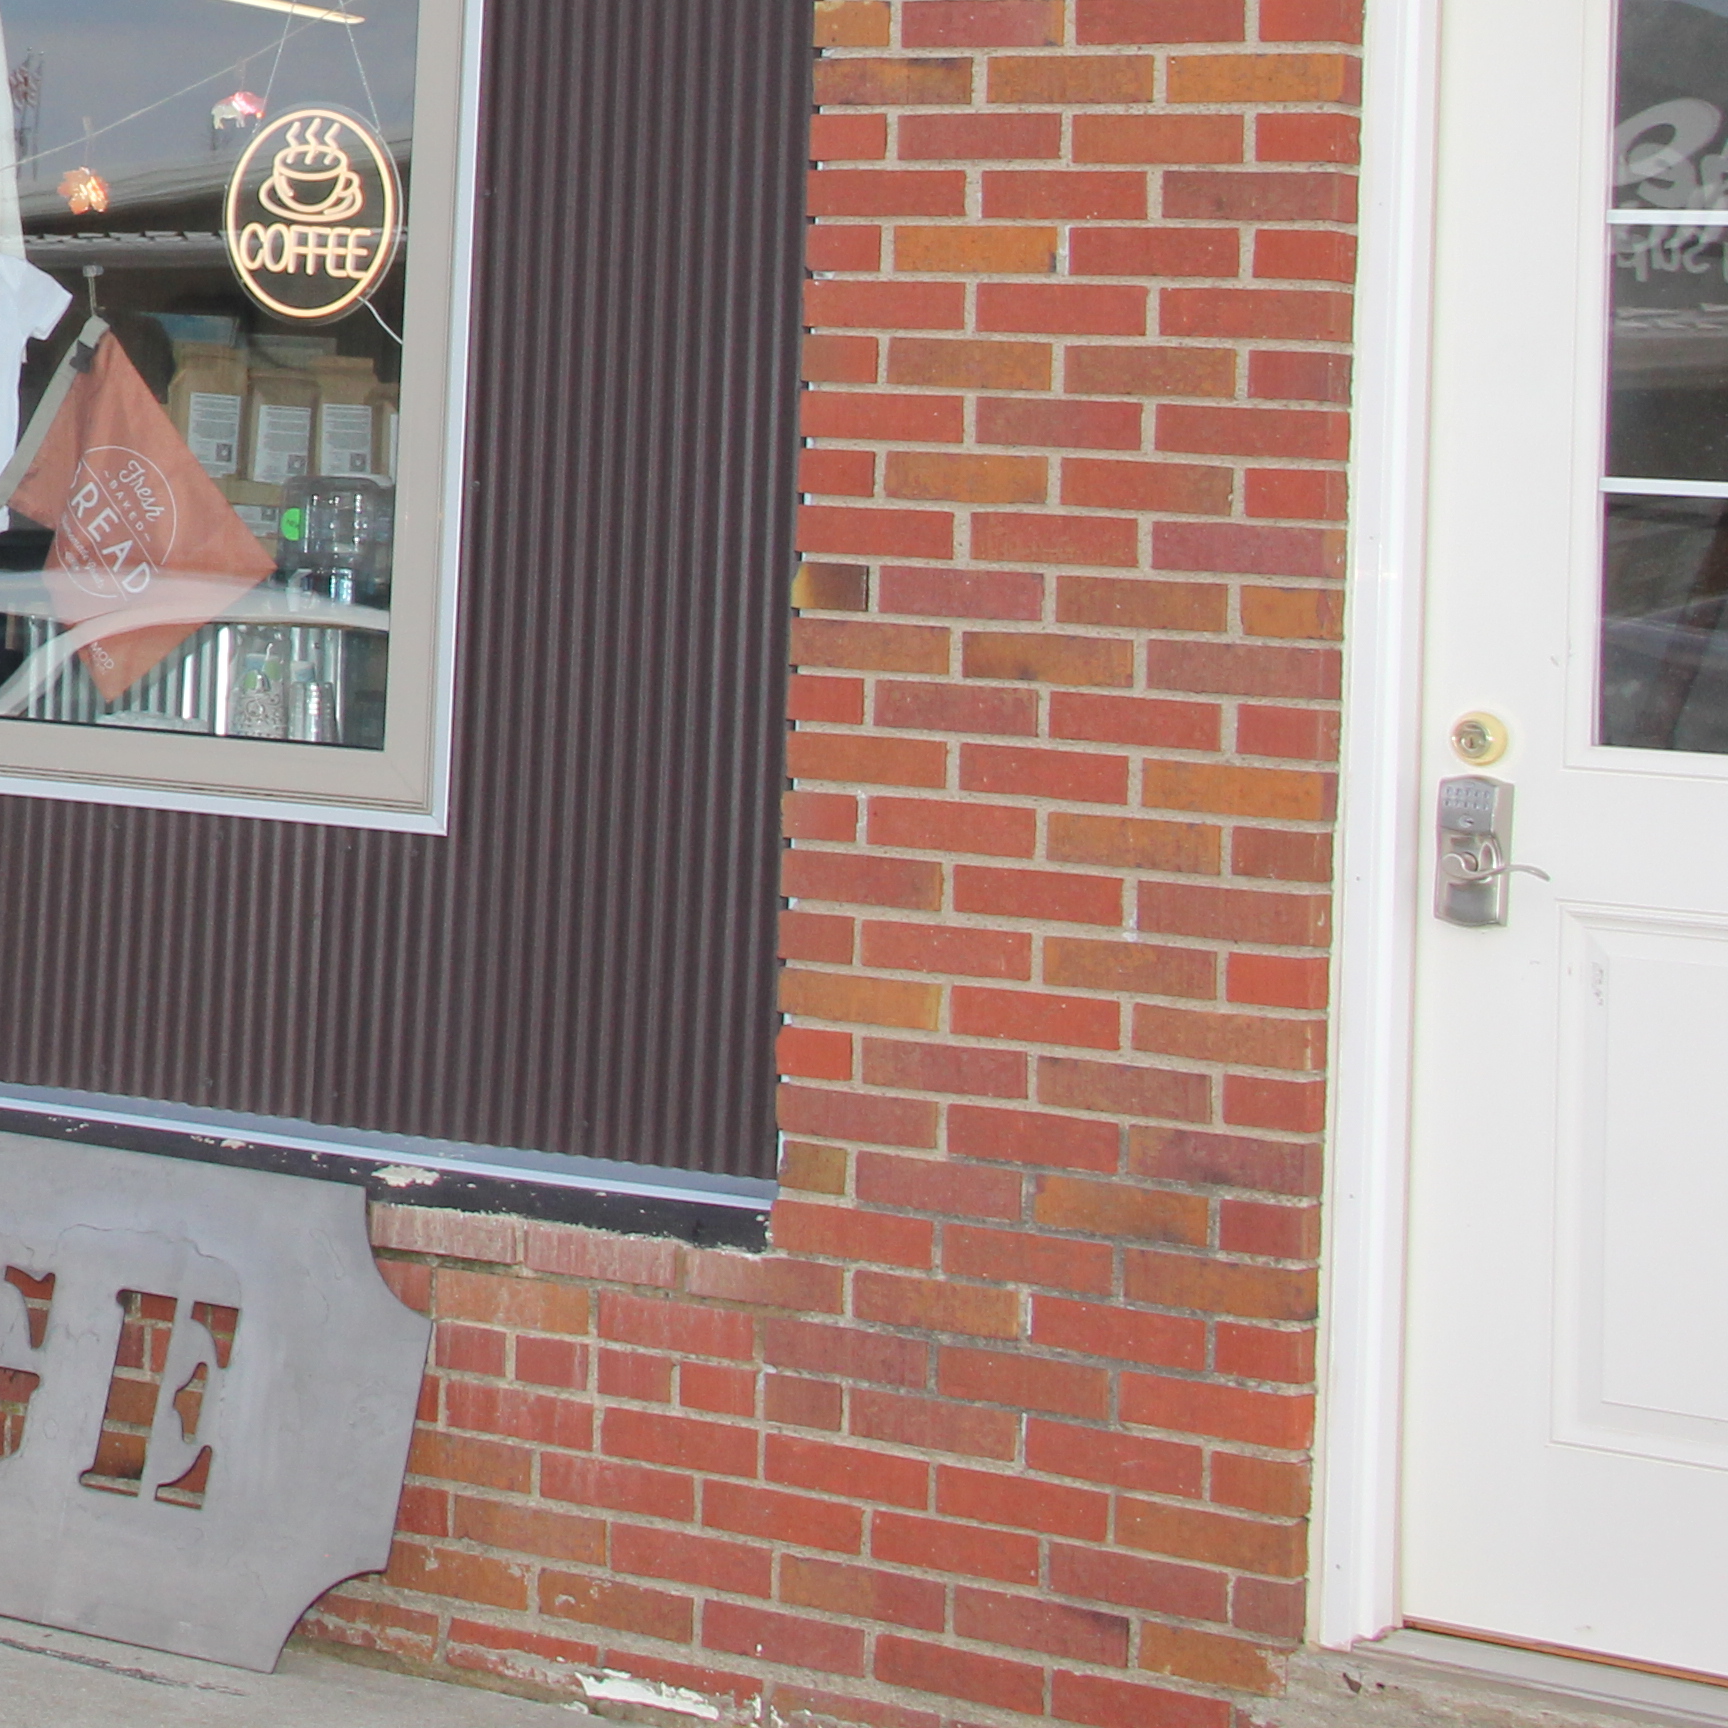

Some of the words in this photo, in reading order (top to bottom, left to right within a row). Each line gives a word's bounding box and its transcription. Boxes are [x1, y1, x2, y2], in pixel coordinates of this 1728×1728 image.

[239, 221, 374, 280] COFFEE
[109, 479, 144, 532] BAKED
[118, 459, 166, 523] Fresh
[70, 462, 151, 594] READ
